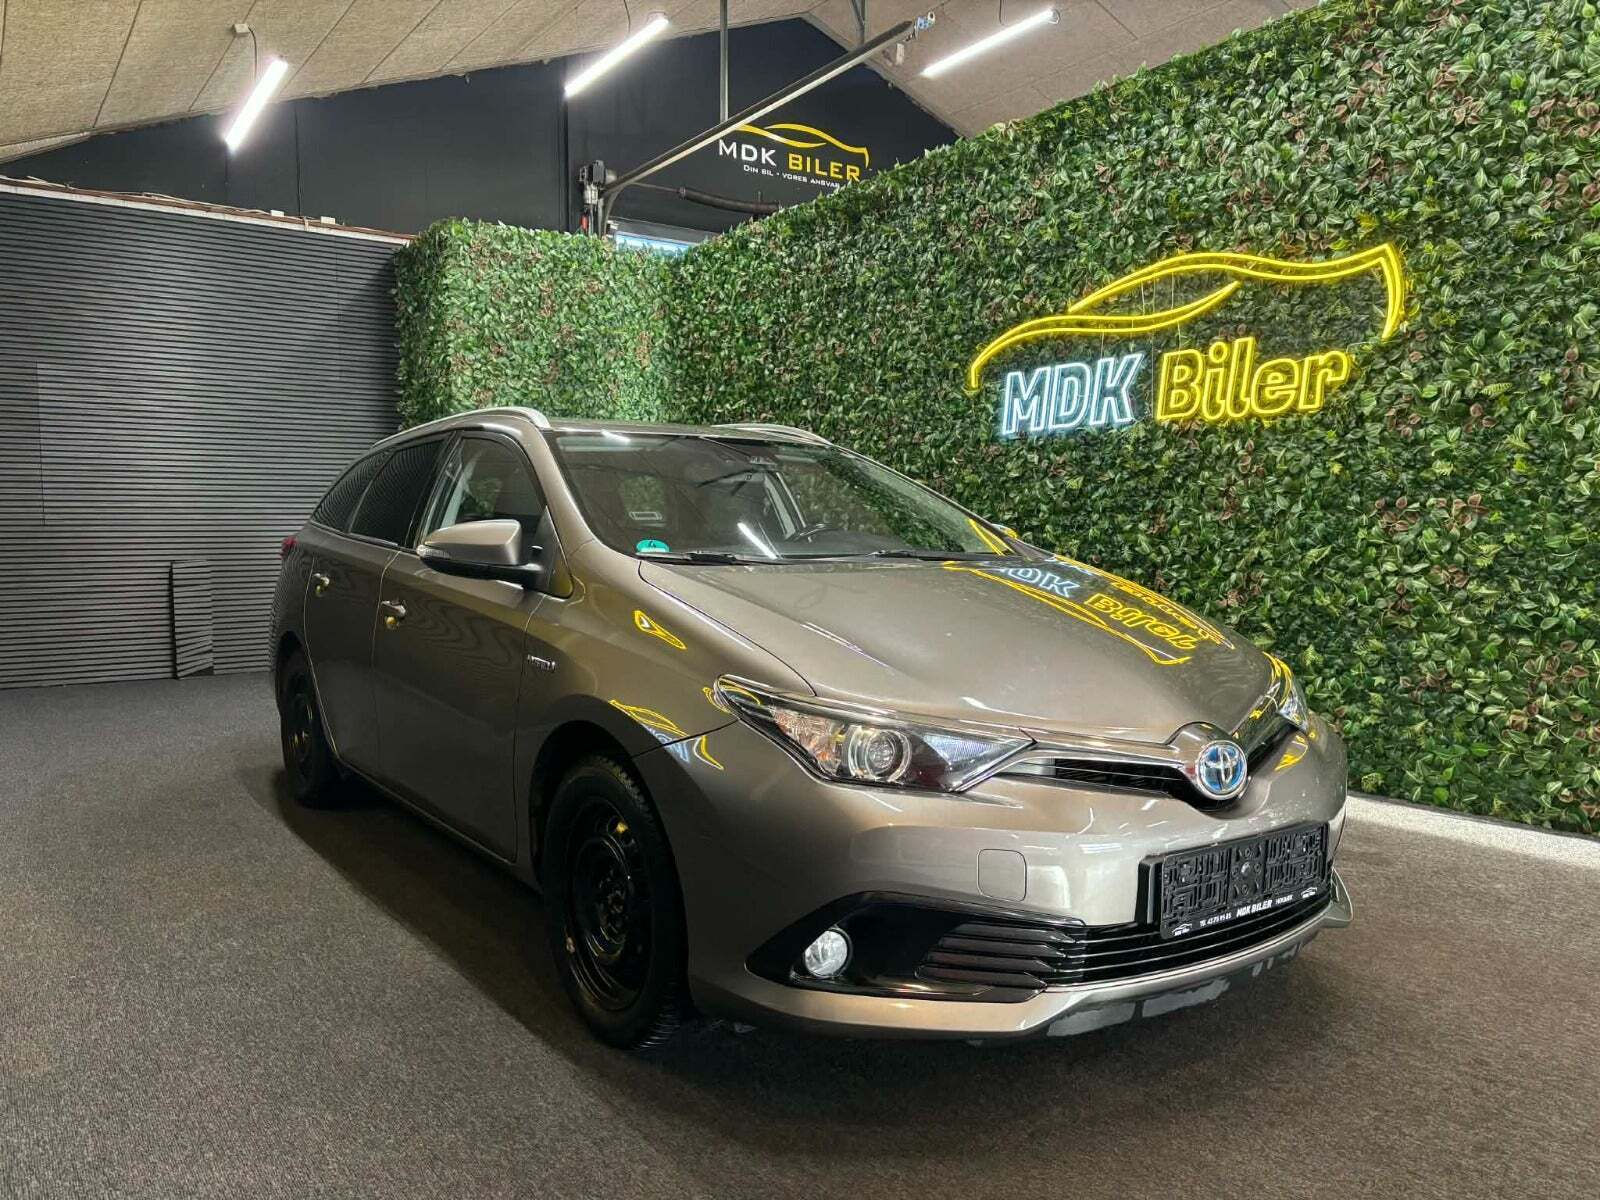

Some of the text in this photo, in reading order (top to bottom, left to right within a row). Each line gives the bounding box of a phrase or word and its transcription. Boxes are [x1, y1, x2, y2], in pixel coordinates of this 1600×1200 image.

[719, 139, 861, 182] MDK BILER
[1002, 337, 1351, 435] MDK Biler
[1251, 900, 1272, 913] BILER
